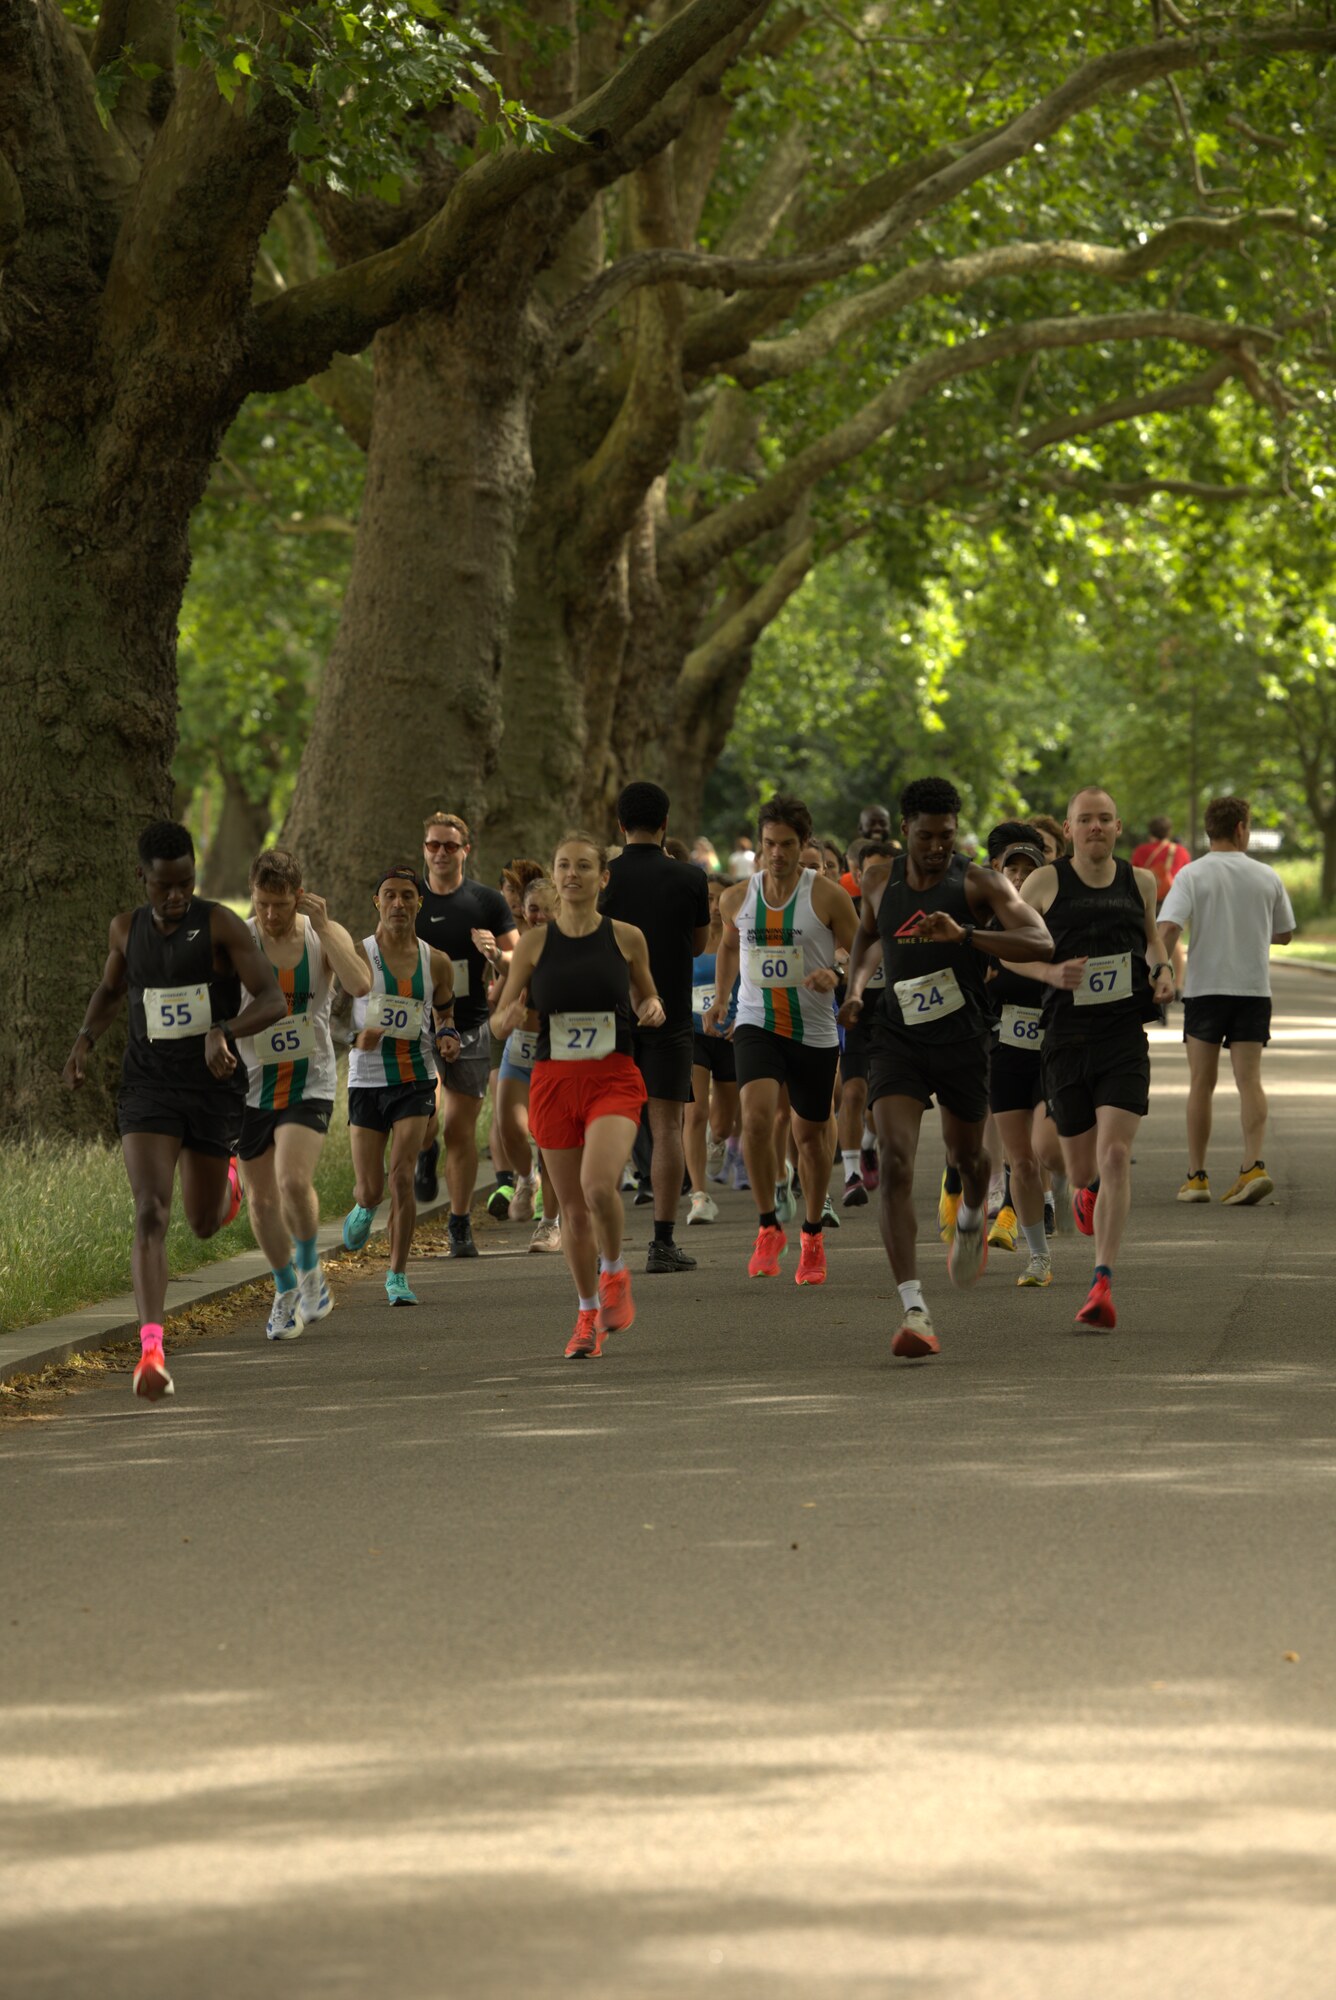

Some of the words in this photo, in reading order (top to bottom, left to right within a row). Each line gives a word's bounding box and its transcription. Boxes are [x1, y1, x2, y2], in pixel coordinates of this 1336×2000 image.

[897, 937, 916, 945] NIKE
[762, 959, 788, 978] 60
[873, 967, 883, 980] 3
[1089, 969, 1117, 993] 67
[912, 985, 944, 1012] 24
[160, 1003, 192, 1027] 55
[380, 1008, 408, 1028] 30
[567, 1028, 597, 1048] 27
[1013, 1020, 1039, 1040] 68
[271, 1029, 300, 1052] 65
